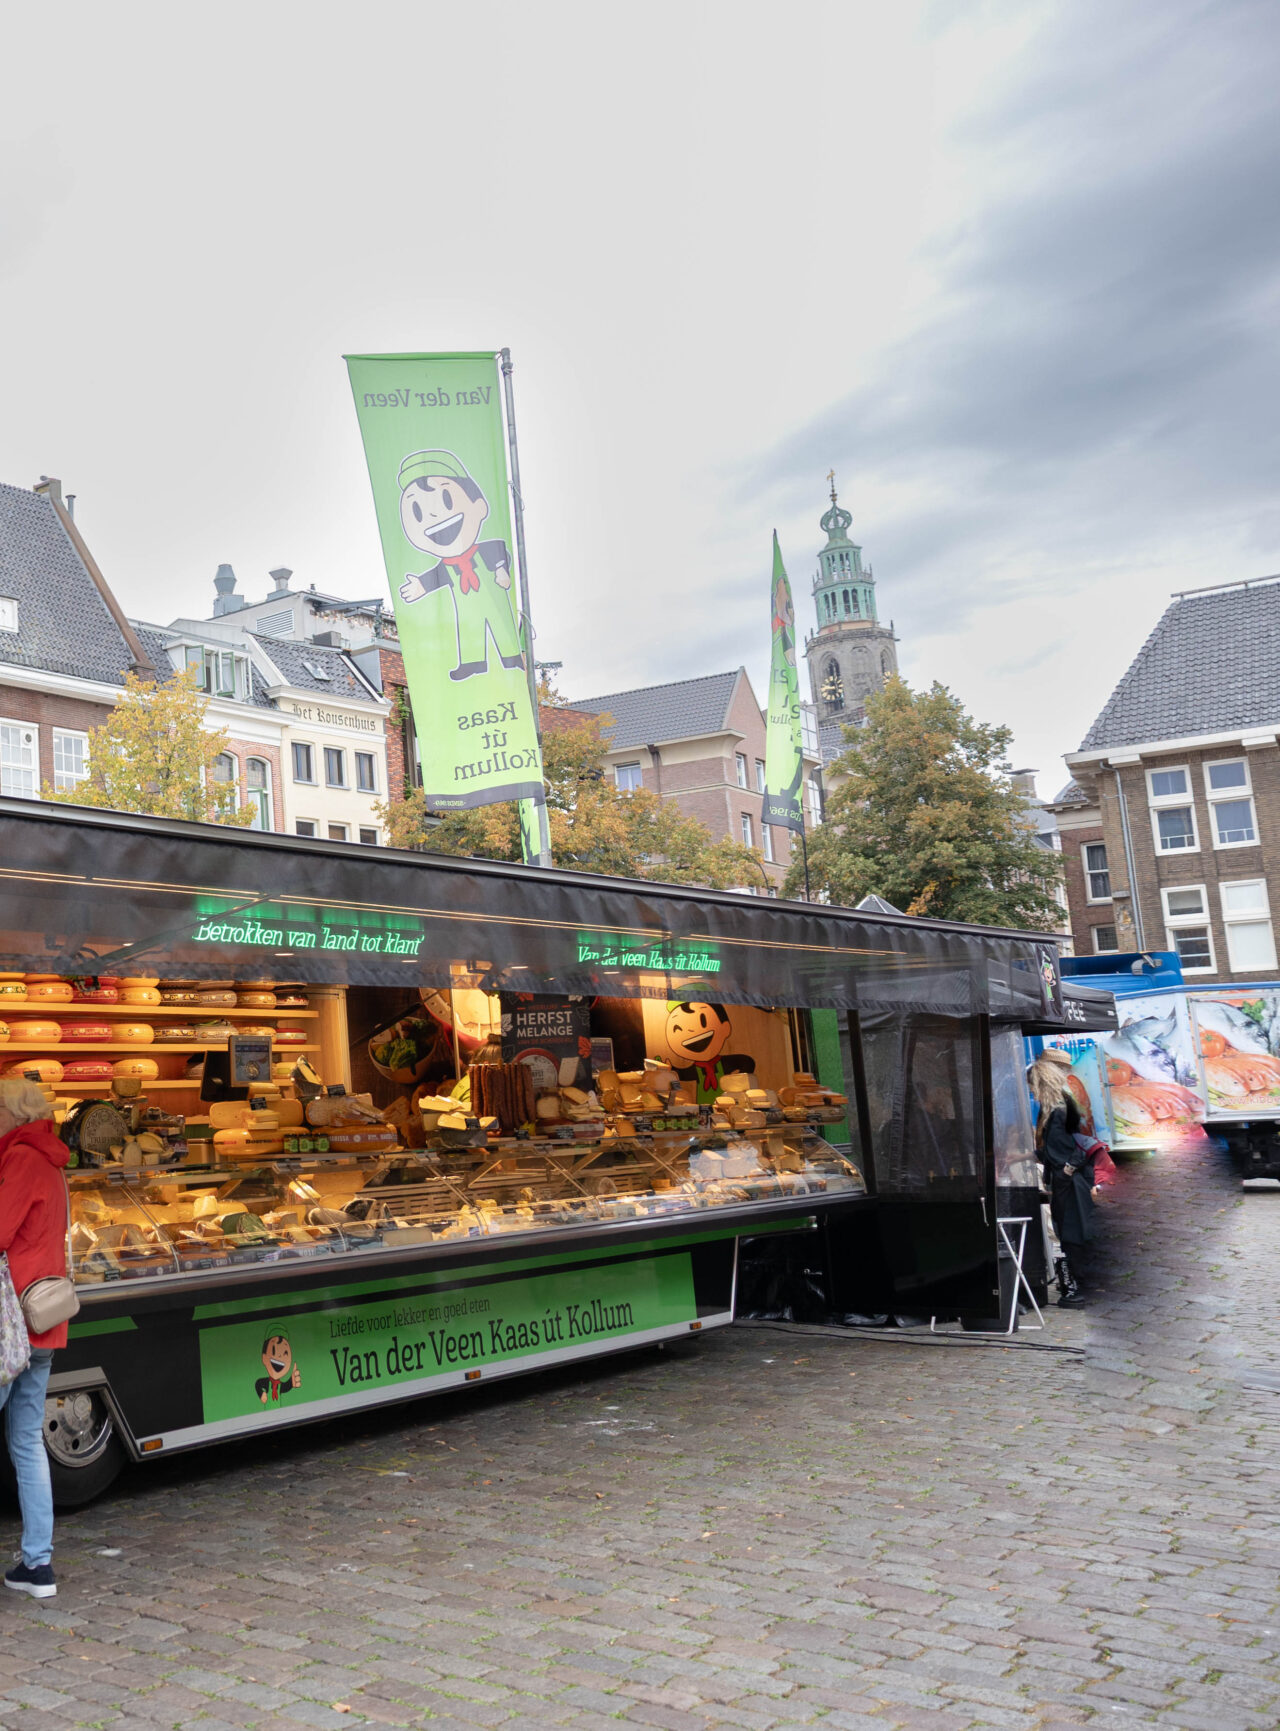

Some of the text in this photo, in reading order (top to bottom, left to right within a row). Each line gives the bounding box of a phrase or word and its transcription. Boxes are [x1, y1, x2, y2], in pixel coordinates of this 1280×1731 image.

[192, 918, 282, 946] Betrokken
[287, 930, 316, 948] van
[360, 934, 383, 952] tot
[517, 1011, 573, 1025] HERFST
[517, 1026, 573, 1038] MELANGE
[329, 1298, 491, 1338] Liefde voor lekker en goed eten
[330, 1299, 634, 1386] Van der Veen Kaas út Kollum
